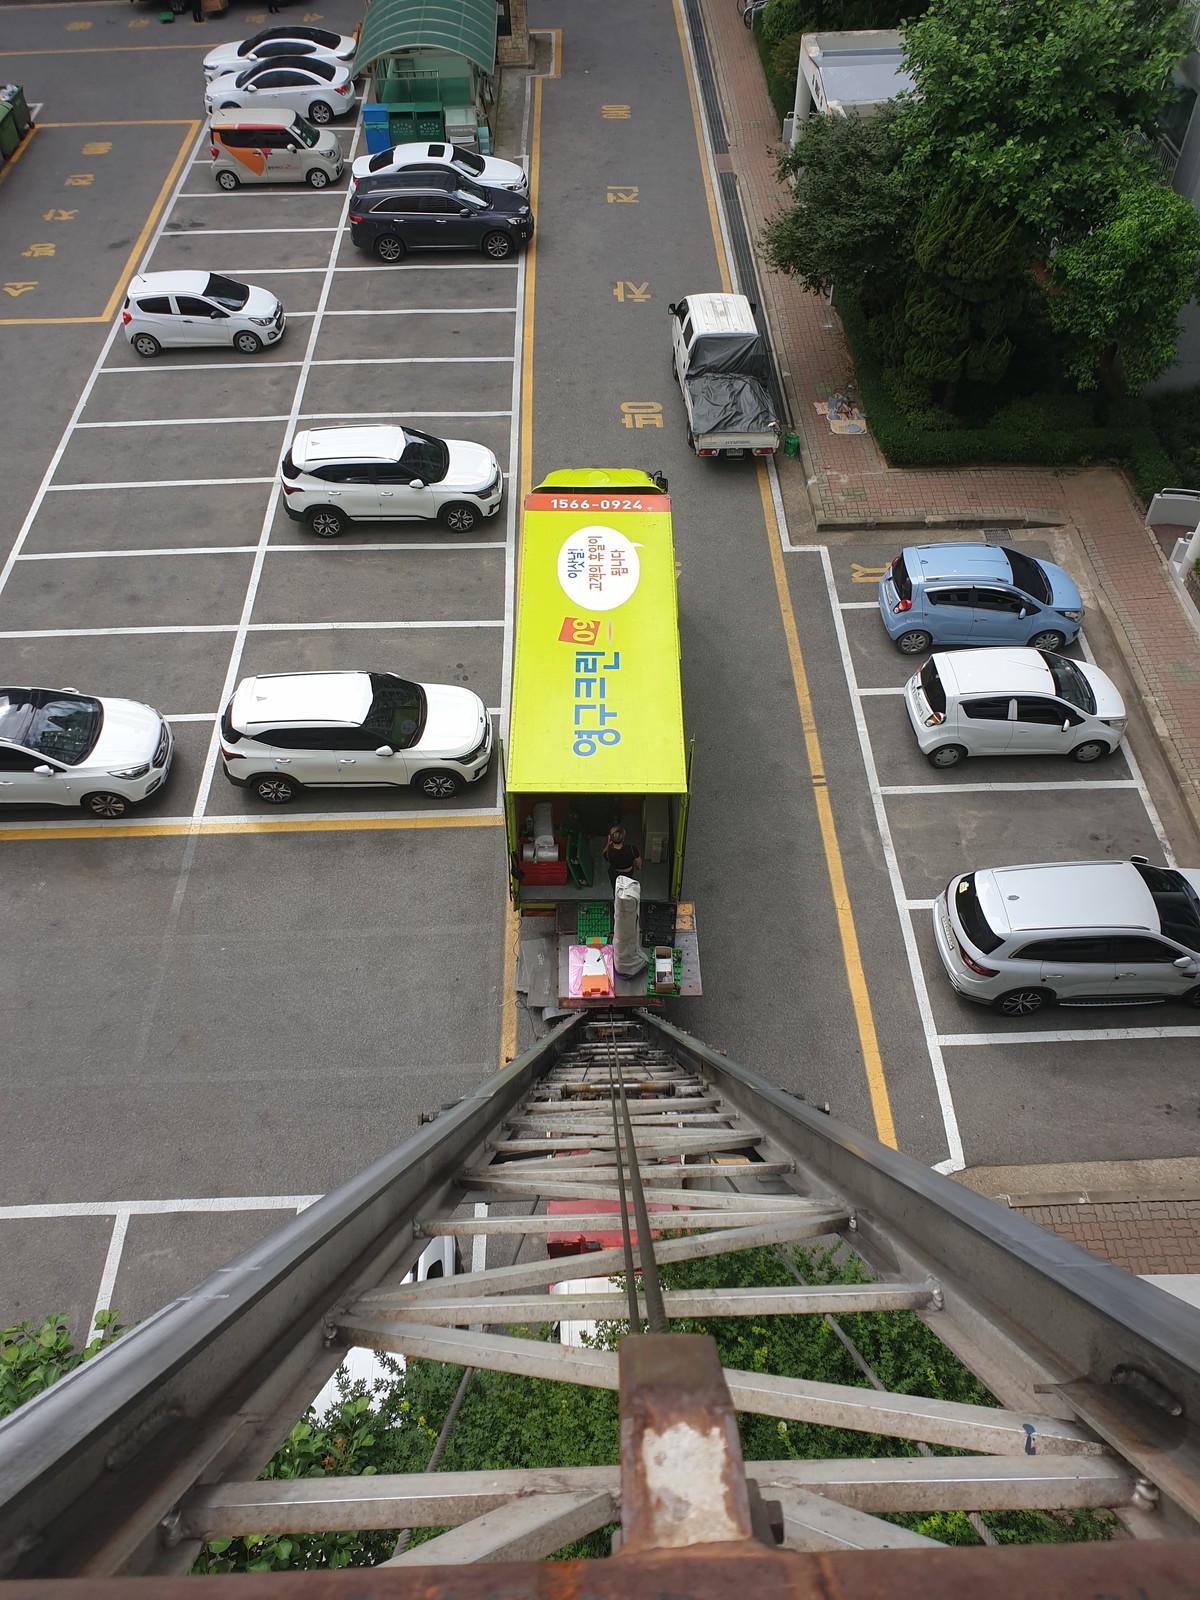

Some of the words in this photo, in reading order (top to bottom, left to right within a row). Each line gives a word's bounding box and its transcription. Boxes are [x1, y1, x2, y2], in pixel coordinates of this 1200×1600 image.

[551, 499, 643, 510] 1566-0924
[588, 535, 606, 562] 휴일이
[568, 548, 585, 579] 이삿날!
[610, 550, 629, 577] 됩니다
[589, 564, 606, 592] 고객의
[572, 618, 596, 643] 09
[572, 651, 621, 757] 영구크린
